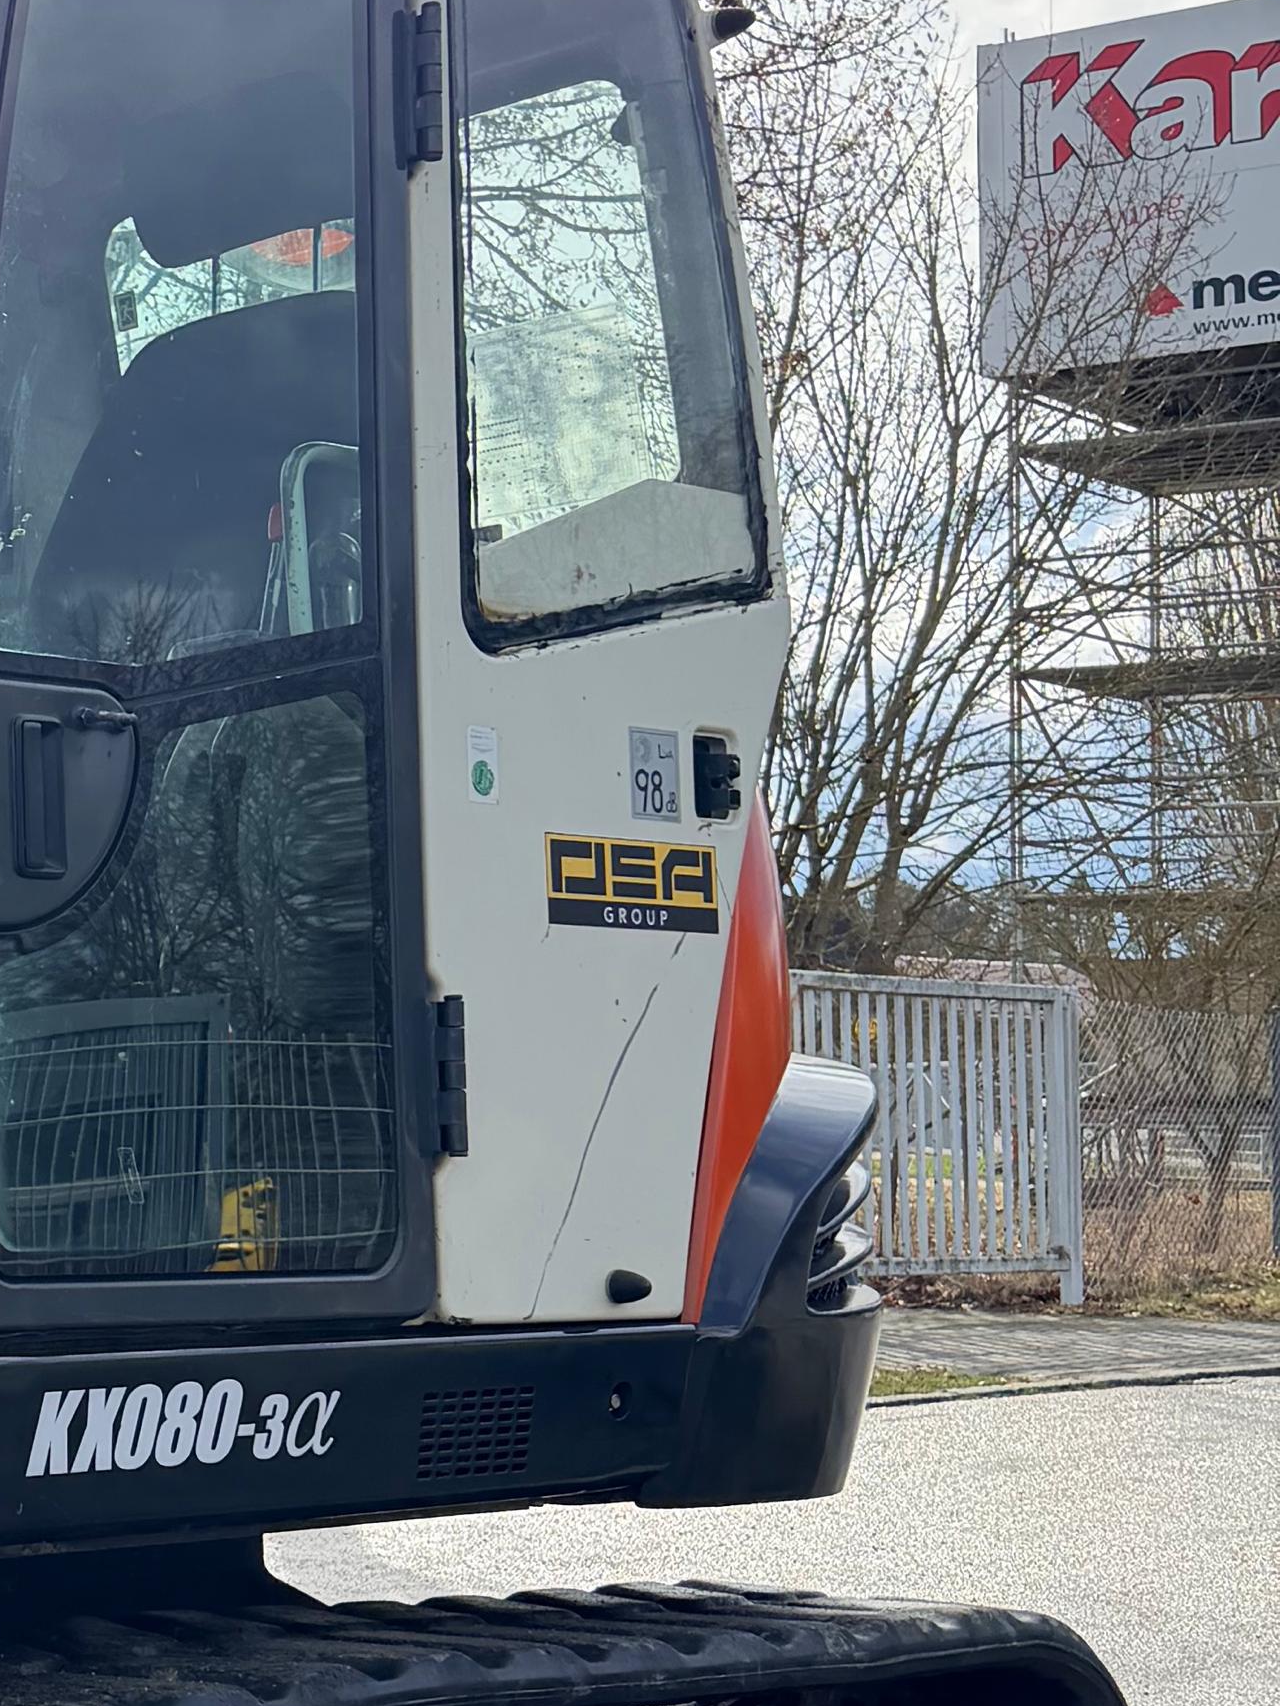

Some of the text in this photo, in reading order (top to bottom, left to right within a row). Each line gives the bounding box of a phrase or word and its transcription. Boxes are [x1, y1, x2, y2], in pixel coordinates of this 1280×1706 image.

[1193, 312, 1280, 334] www.m
[635, 768, 663, 813] 98
[603, 906, 669, 926] GROUP
